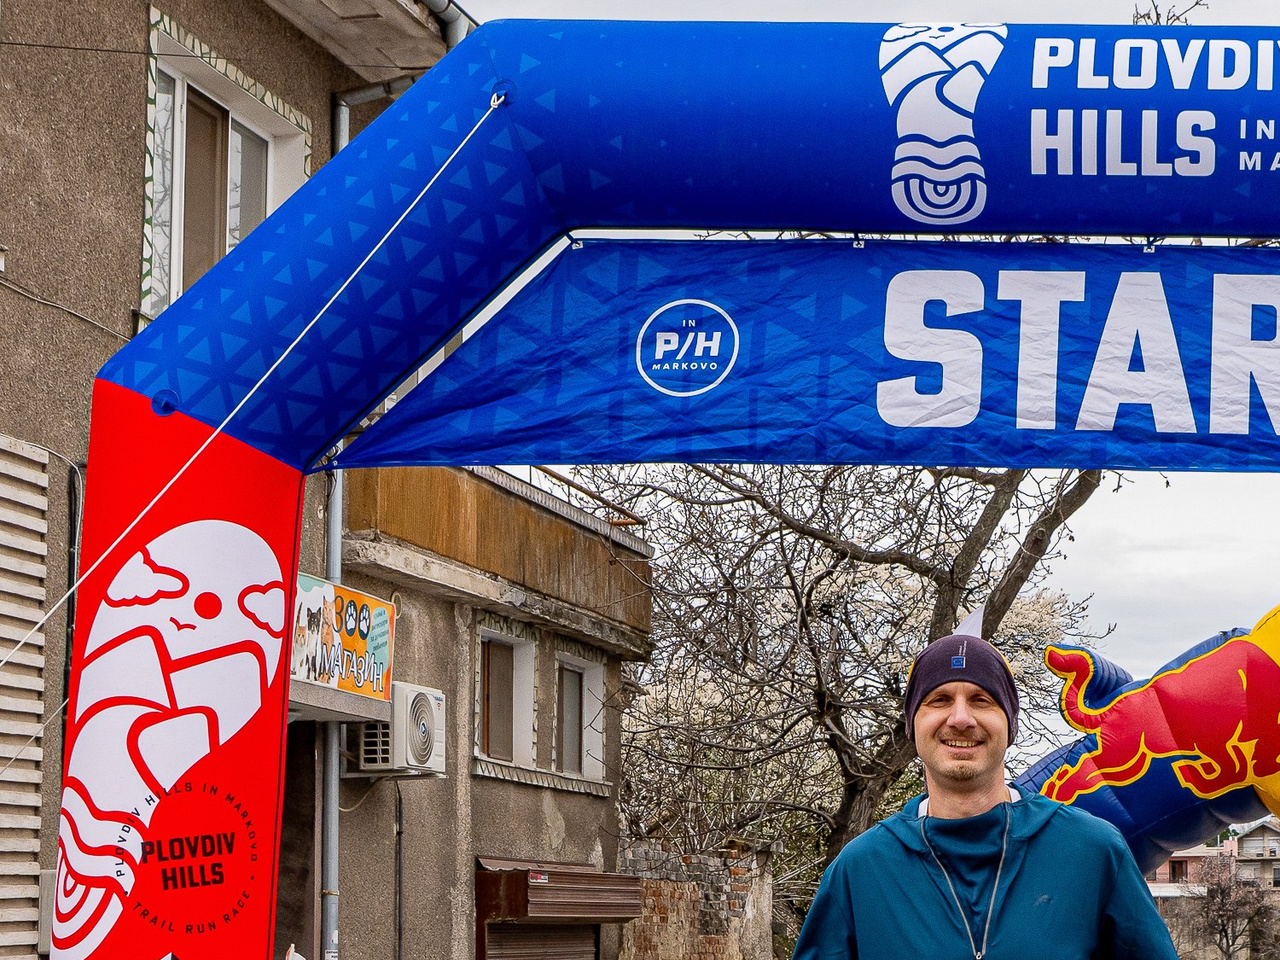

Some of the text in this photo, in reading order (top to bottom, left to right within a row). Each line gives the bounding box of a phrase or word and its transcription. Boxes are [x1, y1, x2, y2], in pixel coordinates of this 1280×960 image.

[1030, 109, 1216, 177] HILLS
[1239, 119, 1276, 140] IN
[682, 319, 696, 327] IN
[654, 331, 722, 360] P/H
[651, 362, 718, 371] MARKOVO
[321, 643, 384, 692] МАГАЗИН
[115, 782, 258, 878] PLOVDIV HILLS IN MARKOVO
[141, 832, 236, 864] PLOVDIV
[161, 862, 225, 891] HILLS
[132, 890, 250, 934] TRAIL RUN RACE
